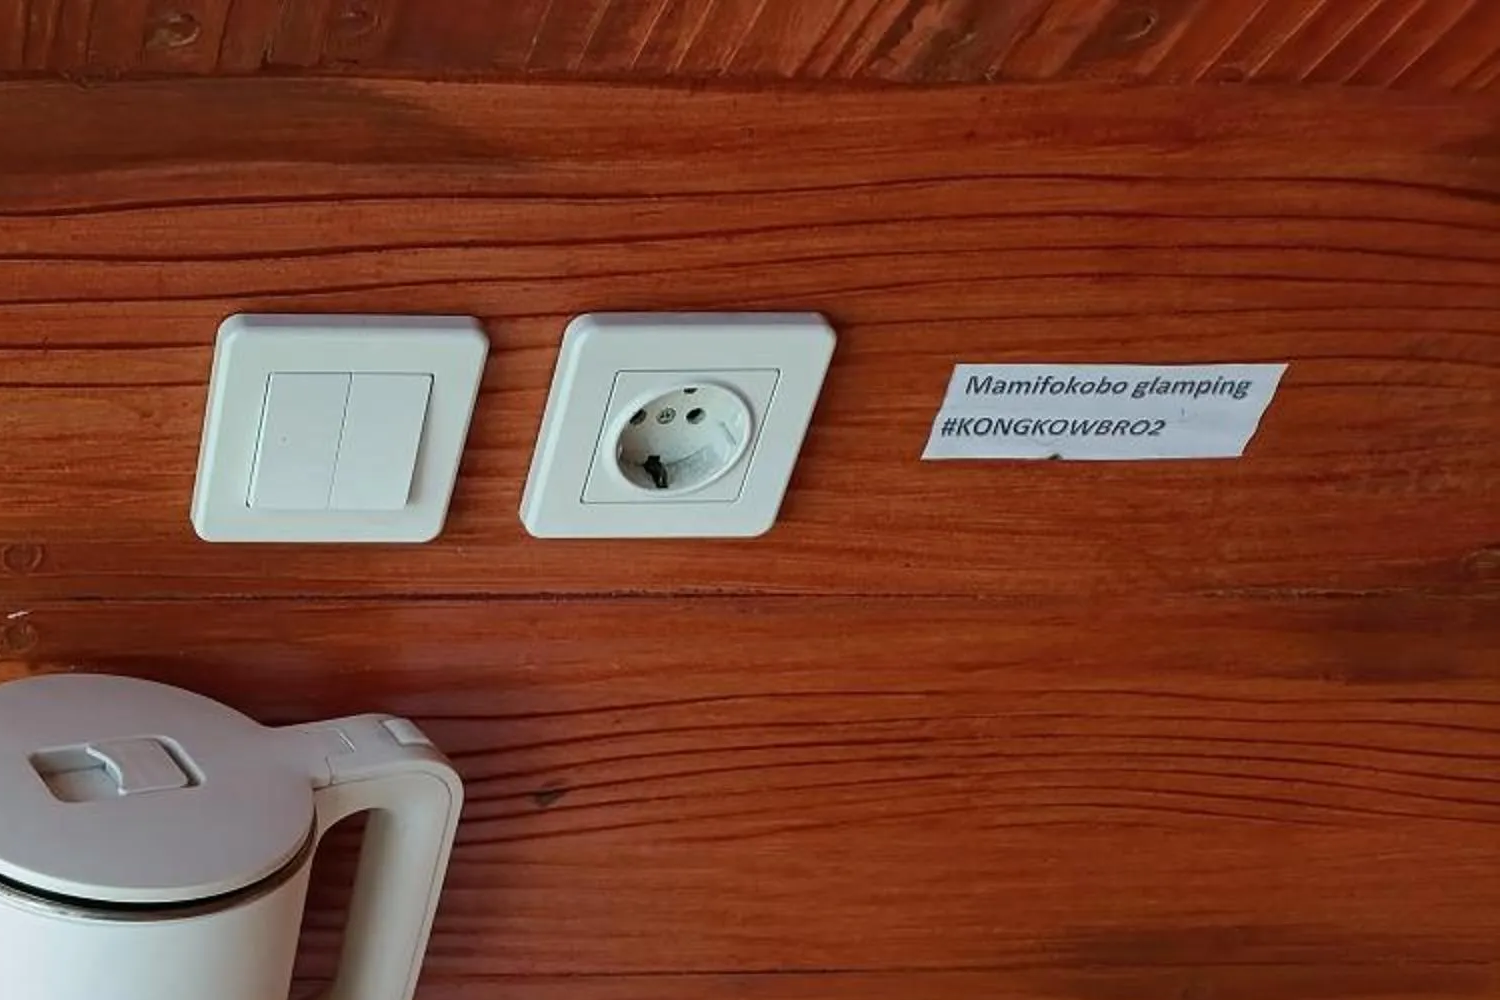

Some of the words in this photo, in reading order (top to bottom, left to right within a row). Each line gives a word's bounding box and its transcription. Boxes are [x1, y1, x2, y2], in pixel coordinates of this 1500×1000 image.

[964, 375, 1128, 396] Mamifokobo
[1131, 376, 1253, 400] glamping
[941, 416, 1167, 437] #KONGKOWBRO2
